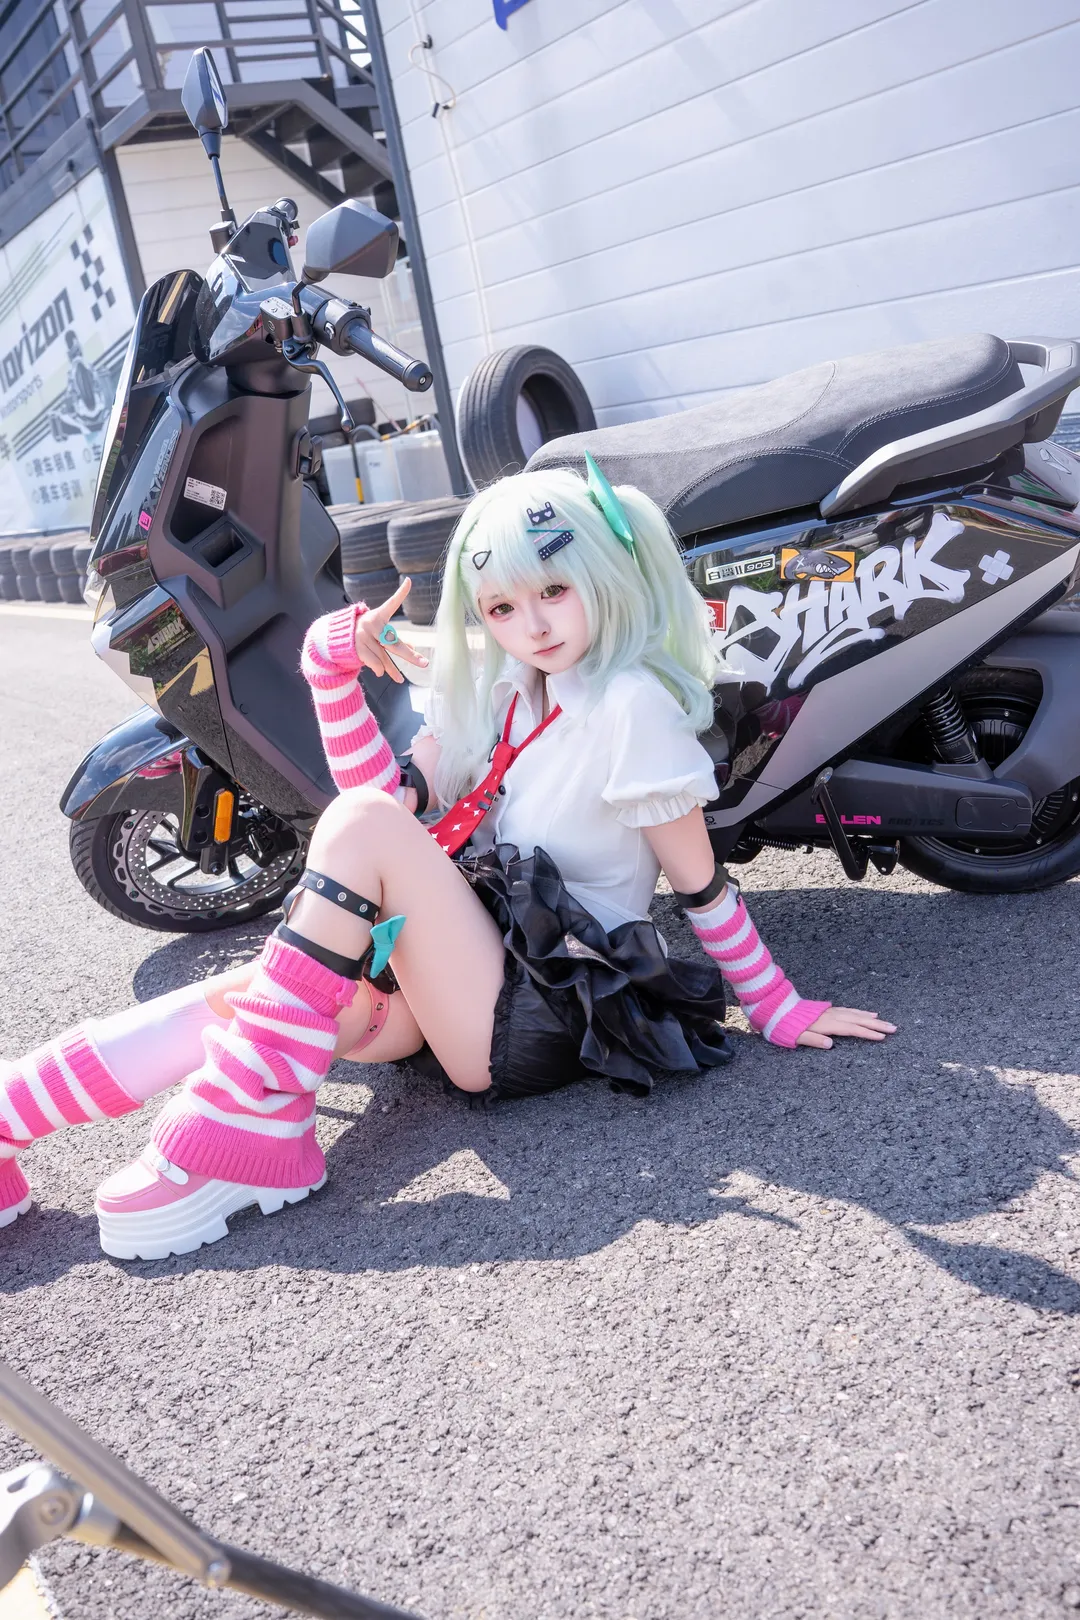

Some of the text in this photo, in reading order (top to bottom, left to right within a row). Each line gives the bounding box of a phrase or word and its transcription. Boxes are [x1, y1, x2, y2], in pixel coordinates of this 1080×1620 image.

[746, 560, 771, 572] 90S
[712, 512, 971, 697] SHARK
[151, 616, 185, 649] SHARK
[815, 813, 881, 825] ELEN
